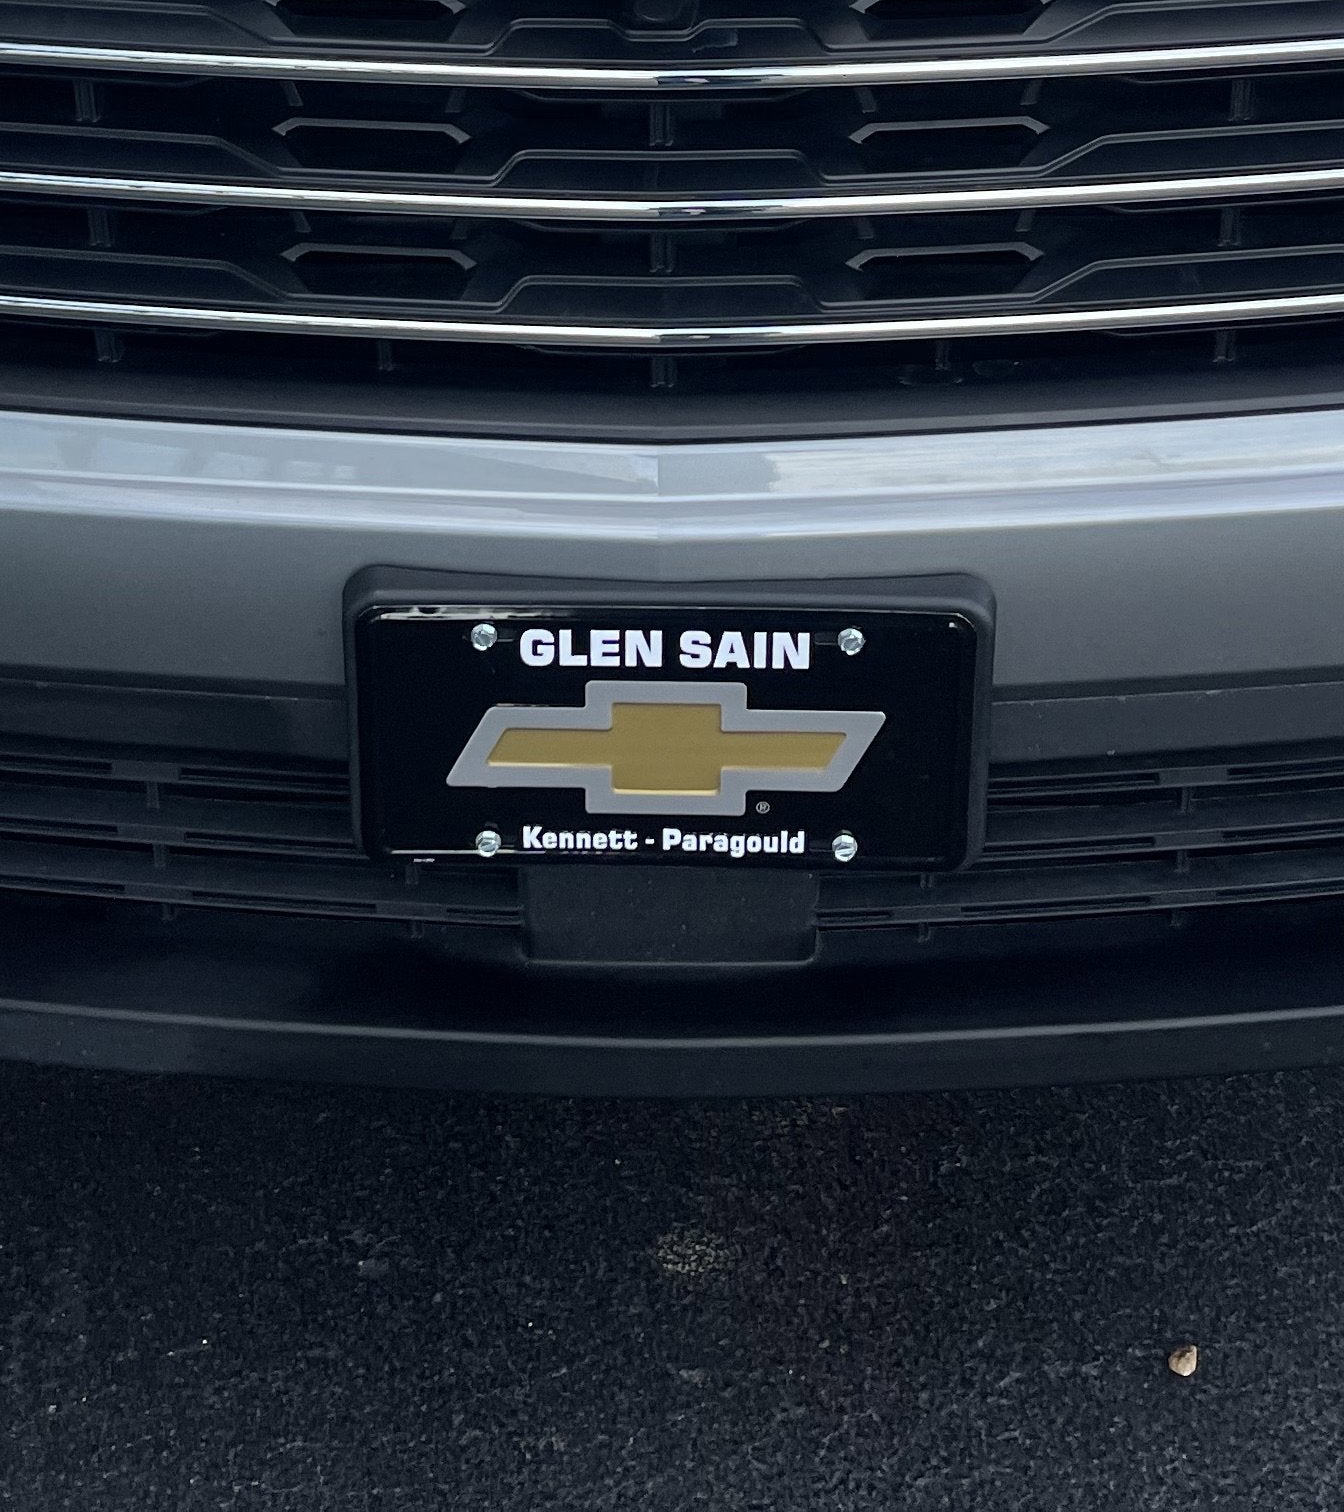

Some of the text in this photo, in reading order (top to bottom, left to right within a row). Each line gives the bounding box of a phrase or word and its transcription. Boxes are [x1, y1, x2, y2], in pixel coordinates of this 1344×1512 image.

[520, 628, 811, 670] GLEN SAIN
[522, 825, 638, 850] Kennett
[661, 826, 806, 859] Paragould
